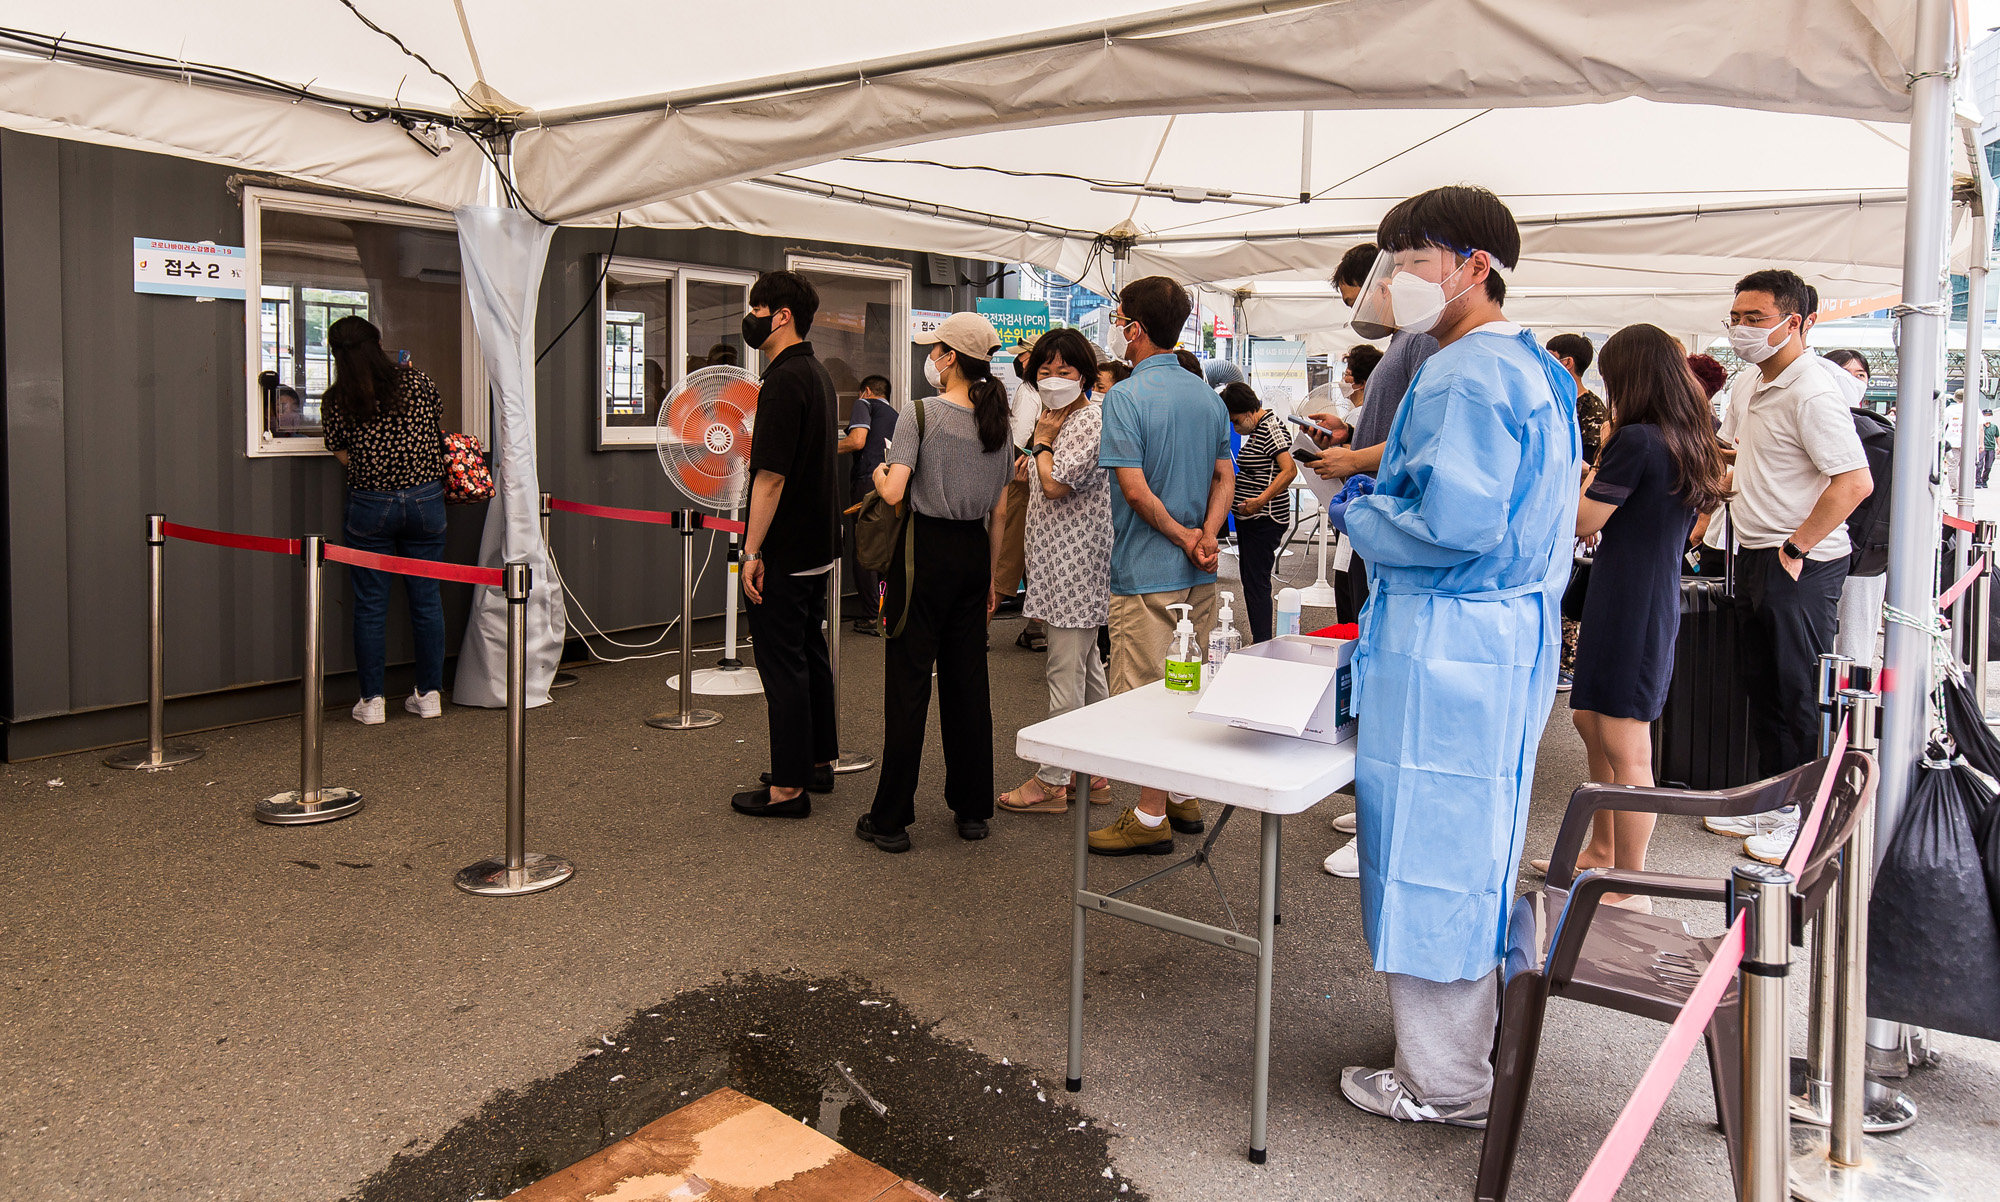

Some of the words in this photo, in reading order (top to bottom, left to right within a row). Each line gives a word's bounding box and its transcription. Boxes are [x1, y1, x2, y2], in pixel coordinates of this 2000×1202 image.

[164, 259, 202, 278] 접수
[207, 263, 220, 279] 2
[921, 321, 935, 332] 접수
[1023, 314, 1046, 327] (PCR)
